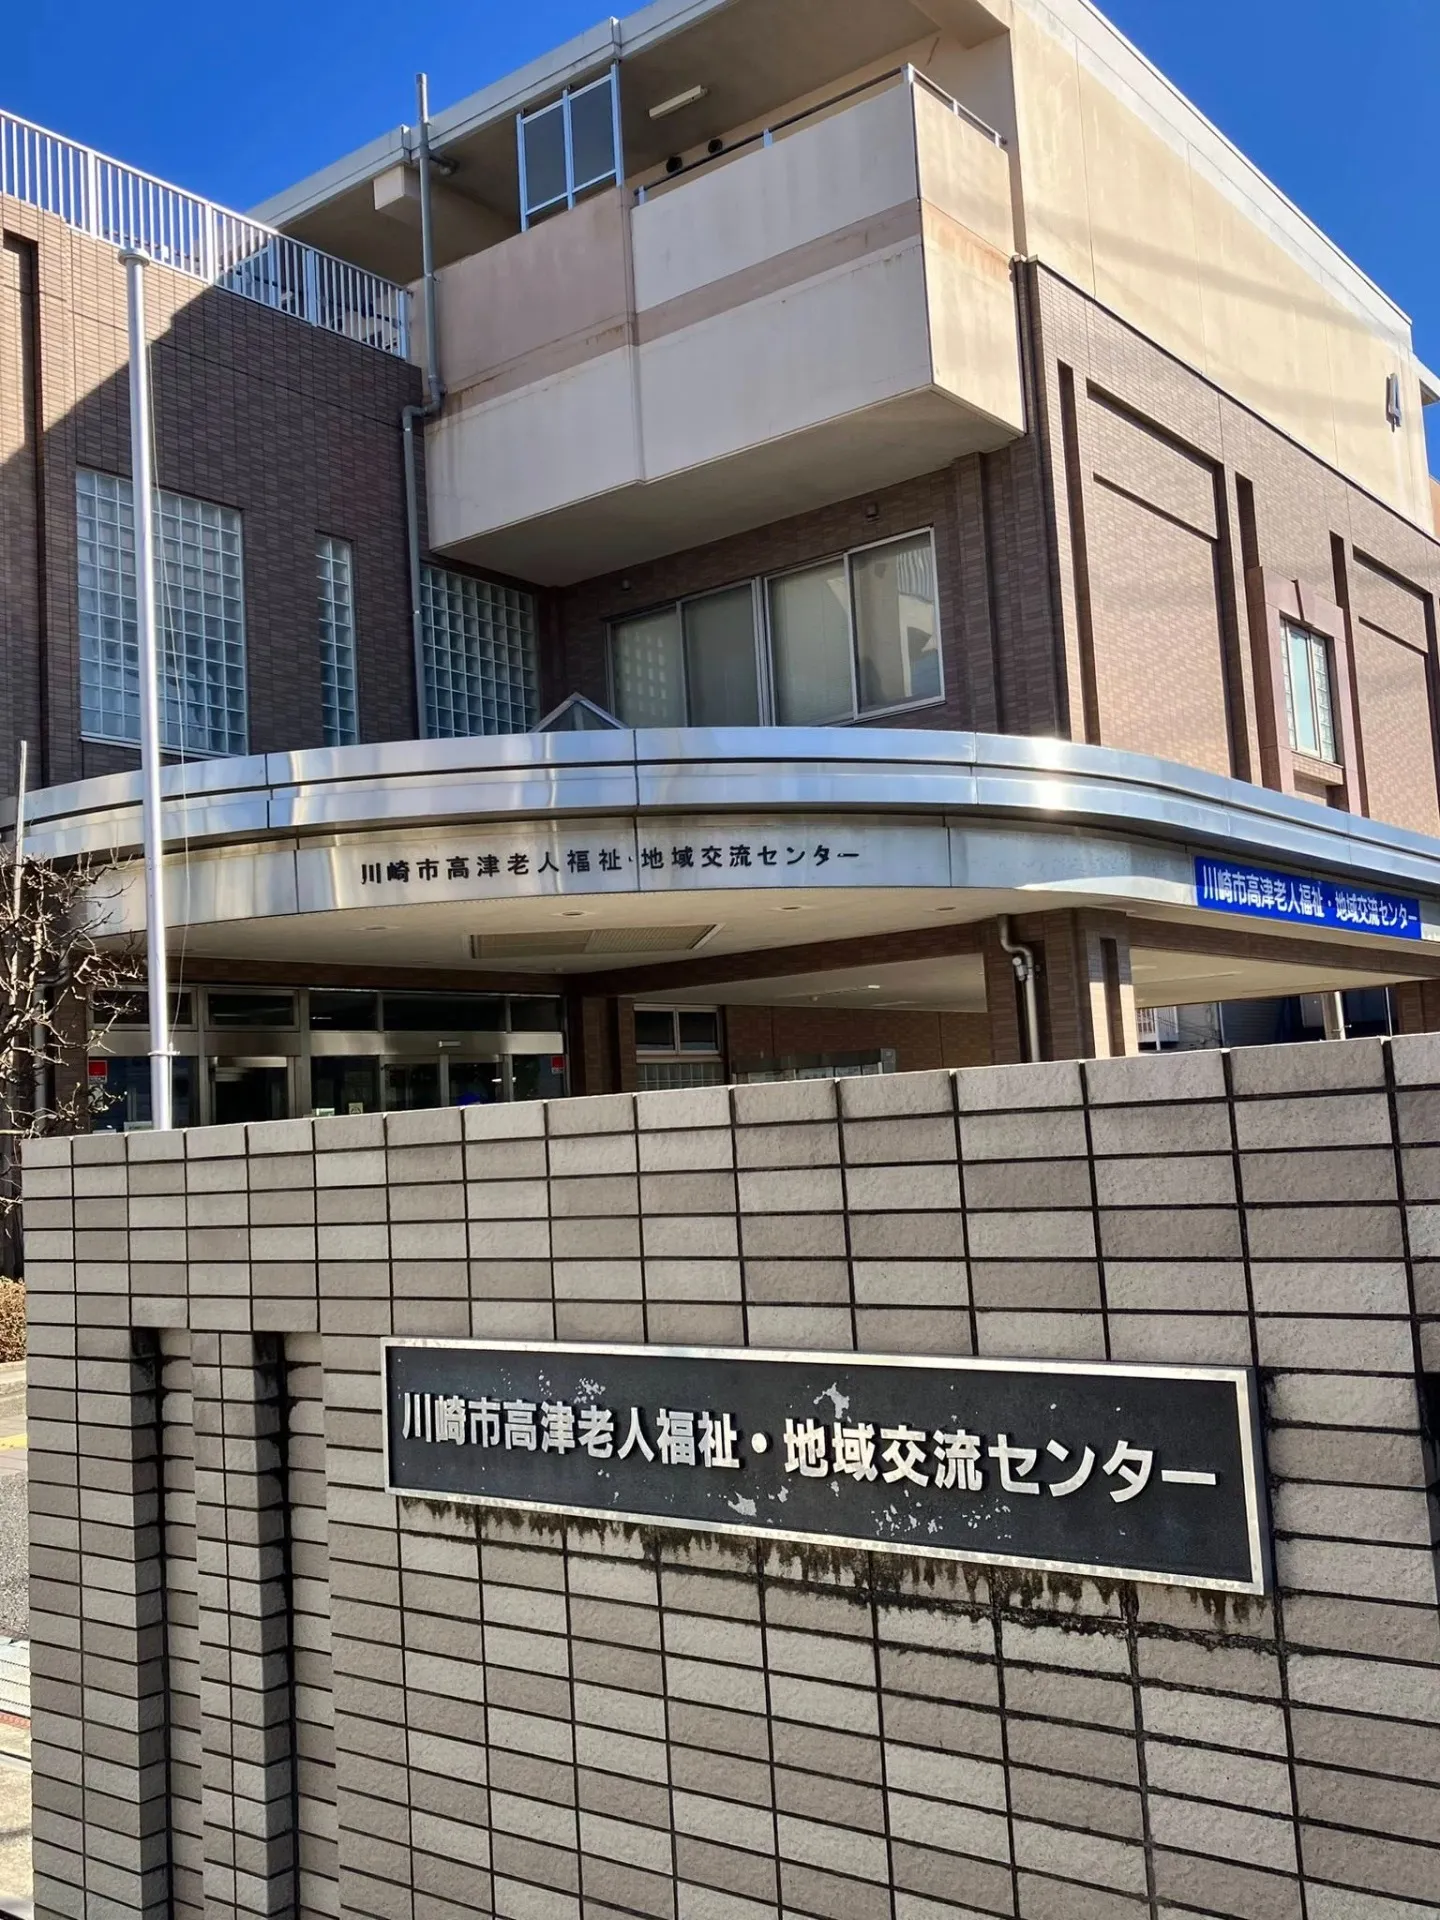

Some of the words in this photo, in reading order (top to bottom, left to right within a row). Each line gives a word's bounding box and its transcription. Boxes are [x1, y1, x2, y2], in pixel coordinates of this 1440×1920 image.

[361, 845, 860, 884] 川崎市高津老人福祉・地域交流センター
[1203, 865, 1417, 929] 川崎市高津老人福祉・地域交流センター
[402, 1391, 1217, 1504] 川崎市高津老人福祉・地域交流センター
